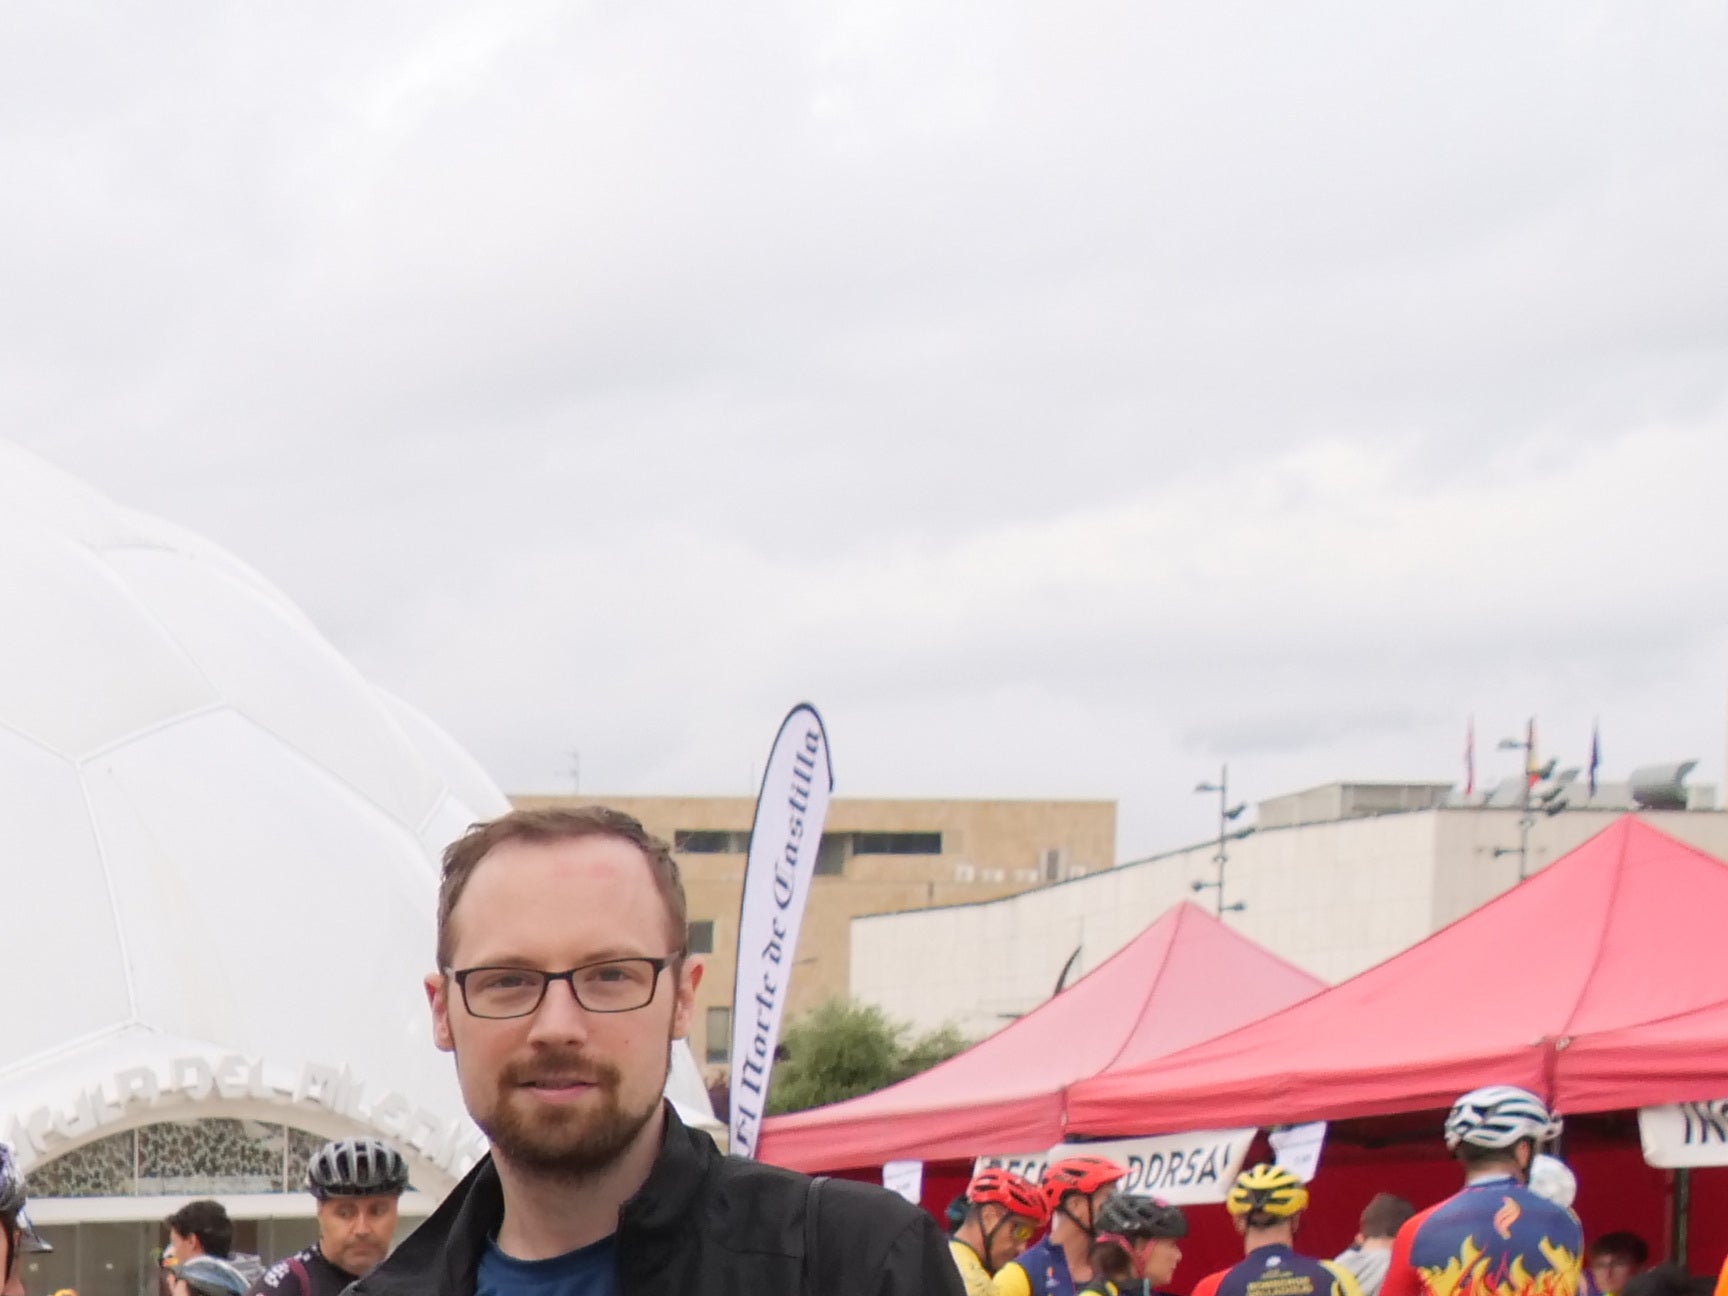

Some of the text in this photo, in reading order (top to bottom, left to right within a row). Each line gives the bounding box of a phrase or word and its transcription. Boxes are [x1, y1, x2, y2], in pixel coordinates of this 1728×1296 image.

[773, 730, 821, 910] Castilla
[761, 916, 788, 965] de
[741, 975, 778, 1098] Norte
